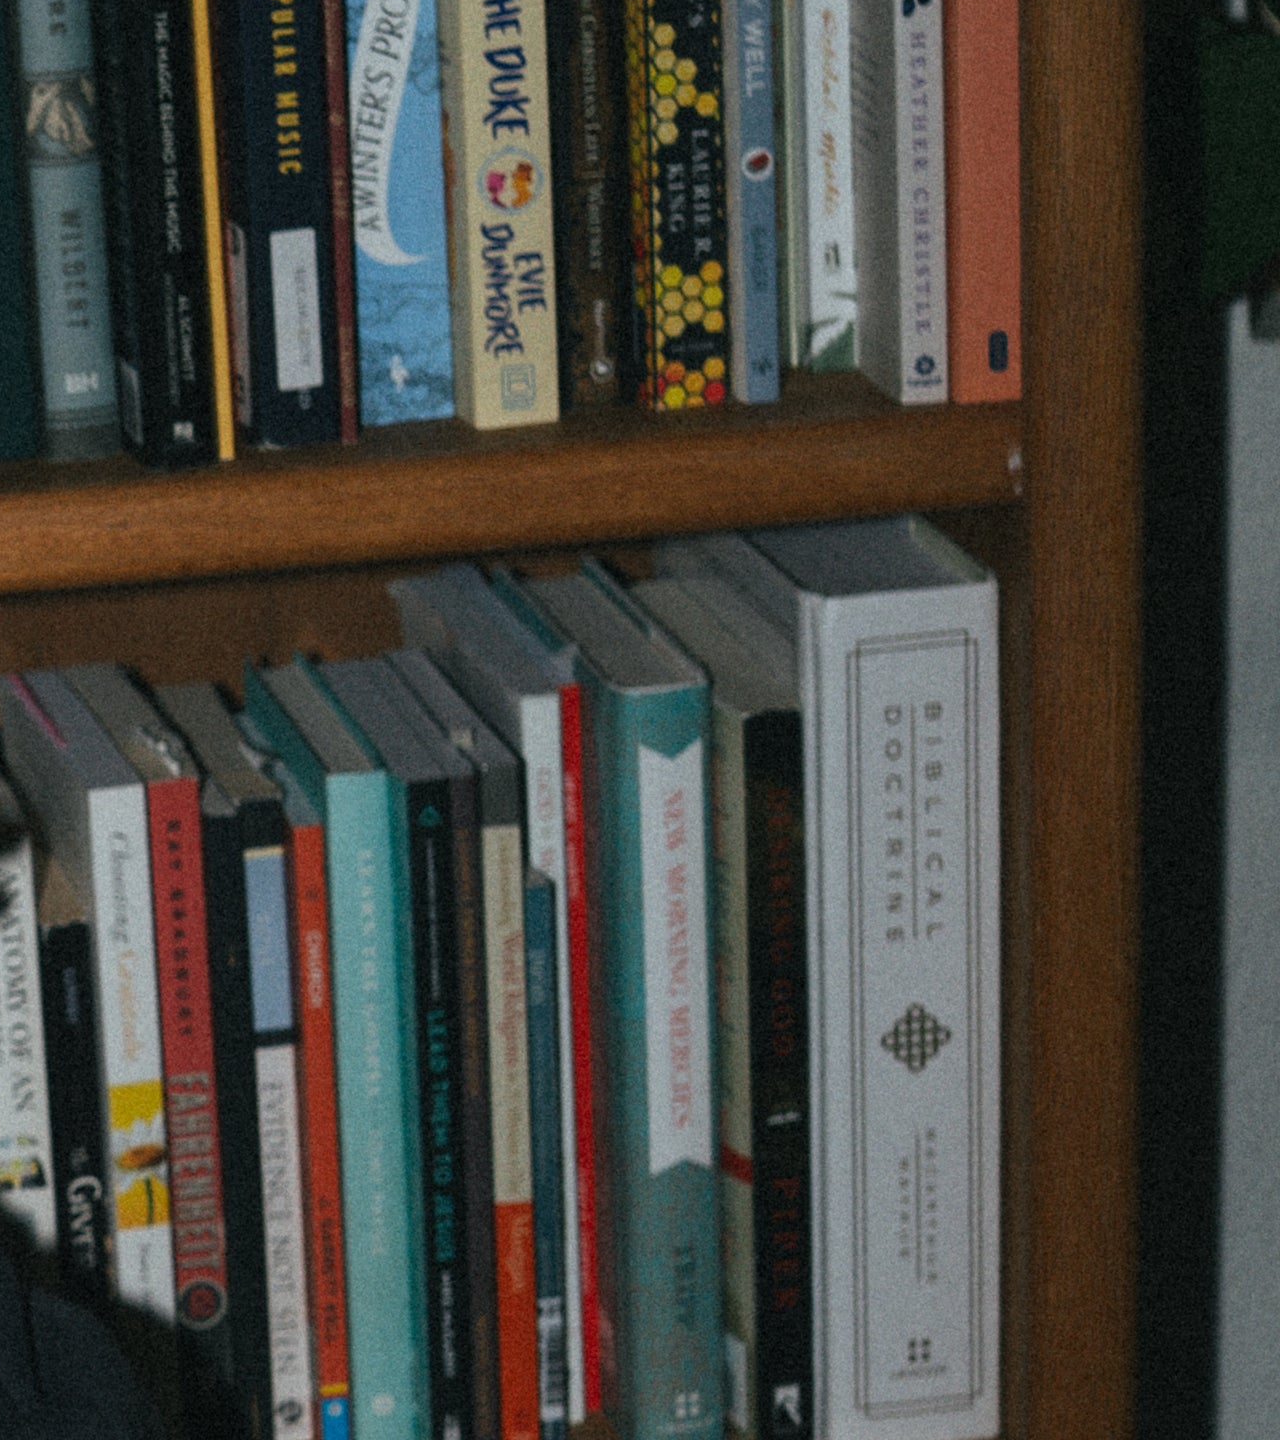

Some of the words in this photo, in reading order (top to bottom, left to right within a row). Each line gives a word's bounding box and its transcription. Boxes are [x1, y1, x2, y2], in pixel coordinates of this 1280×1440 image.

[275, 91, 304, 177] MUSIC
[346, 67, 398, 213] WINTER'S
[482, 47, 530, 139] DUKE
[358, 212, 384, 233] A
[514, 251, 547, 312] EVIE
[479, 223, 522, 357] DUNMORE
[764, 786, 792, 961] DESIRING
[882, 704, 906, 941] DOCTRINE
[922, 700, 945, 940] BIBLICAL
[768, 978, 794, 1057] GOD
[166, 1071, 224, 1271] FAHRENHEIT
[771, 1176, 801, 1311] PIPER
